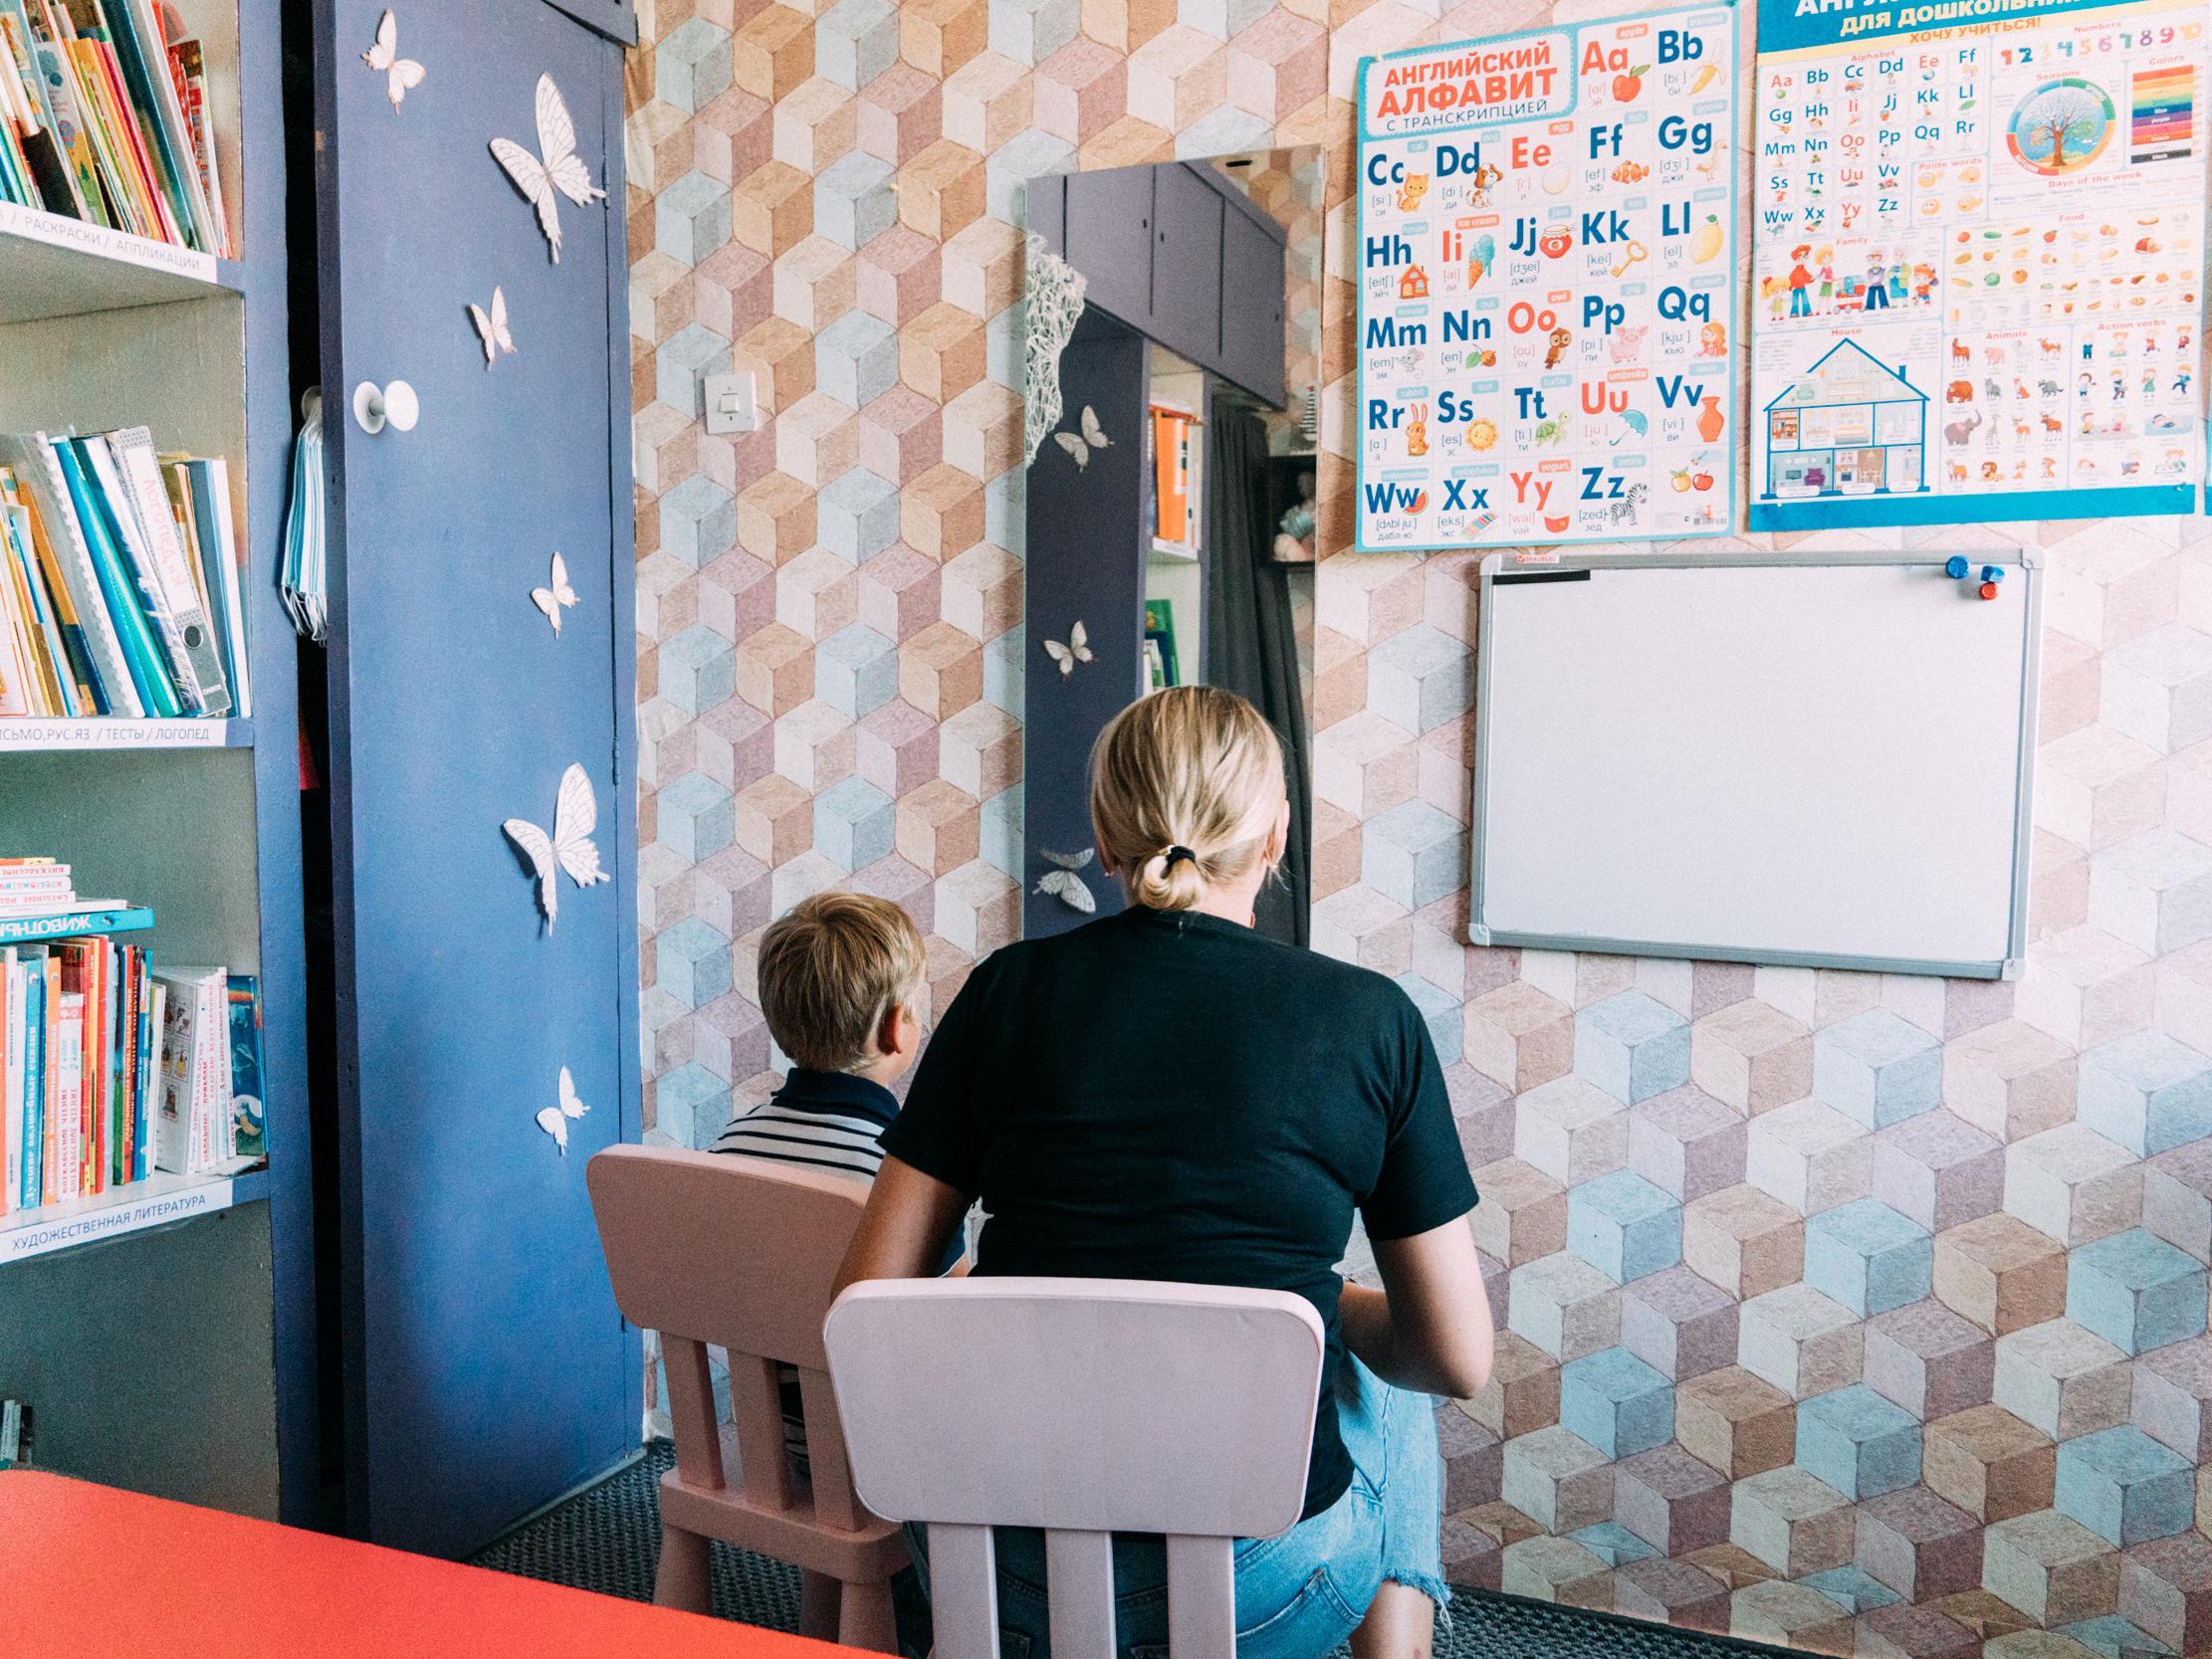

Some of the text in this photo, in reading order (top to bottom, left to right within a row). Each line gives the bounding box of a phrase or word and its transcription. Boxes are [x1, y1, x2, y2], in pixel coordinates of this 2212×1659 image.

[1840, 12, 1890, 37] ДЛЯ
[1909, 17, 2041, 44] ХОЧУ УЧИТЬСЯ!
[2074, 21, 2121, 33] Numbers
[1580, 41, 1628, 76] Aa
[1659, 30, 1702, 64] Bb
[1959, 48, 1976, 63] Ff
[2001, 50, 2012, 65] 1
[2018, 47, 2033, 64] 2
[2058, 41, 2073, 57] 4
[2080, 38, 2092, 55] 5
[2099, 36, 2112, 52] 6
[2140, 30, 2152, 46] 8
[2159, 27, 2174, 44] 9
[1385, 40, 1550, 88] АНГЛИЙСКИЙ
[1845, 65, 1865, 79] Cc
[1880, 58, 1903, 75] Dd
[1919, 55, 1939, 69] Ee
[2149, 55, 2185, 66] Colors
[1771, 75, 1793, 88] Aa
[1807, 69, 1829, 85] Bb
[1378, 68, 1557, 117] АЛФАВИТ
[1883, 94, 1896, 110] Jj
[1917, 89, 1939, 104] Kk
[1959, 85, 1974, 99] Ll
[1387, 100, 1547, 131] С ТРАНСКРИПЦИЕЙ
[1769, 108, 1792, 124] Gg
[1806, 103, 1829, 117] Hh
[1849, 100, 1859, 112] Ii
[1659, 115, 1712, 154] Gg
[1880, 129, 1900, 145] Pp
[1914, 125, 1940, 140] Qq
[1956, 120, 1975, 134] Rr
[1512, 136, 1551, 169] Ee
[1591, 123, 1623, 159] Ff
[1765, 142, 1795, 156] Mm
[1805, 138, 1828, 151] Nn
[1841, 134, 1865, 147] Oo
[1368, 154, 1403, 186] Cc
[1437, 141, 1479, 177] Dd
[1879, 164, 1900, 177] Vv
[1771, 176, 1788, 189] Ss
[1808, 172, 1824, 185] Tt
[1841, 168, 1864, 181] Uu
[1764, 210, 1793, 224] Ww
[1805, 207, 1825, 220] Xx
[1842, 203, 1861, 219] Yy
[1879, 198, 1898, 212] Zz
[1458, 216, 1498, 228] ice cream
[1582, 210, 1630, 246] Kk
[1662, 201, 1690, 237] Ll
[25, 215, 200, 270] РАСКРАСКИ АППЛИКАЦИИ
[1442, 231, 1461, 263] Ii
[1509, 217, 1536, 257] Jj
[1367, 235, 1412, 268] Hh
[1551, 293, 1567, 303] owl
[1658, 286, 1709, 322] Qq
[1443, 310, 1491, 342] Nn
[1507, 302, 1556, 334] Oo
[1583, 296, 1625, 334] Pp
[2098, 318, 2166, 331] Action verbs
[1366, 316, 1427, 348] Mm
[1986, 330, 2028, 340] Animals
[1514, 387, 1547, 419] Tt
[1582, 381, 1628, 414] Uu
[1656, 375, 1703, 409] Vv
[1369, 399, 1405, 430] Rr
[1438, 390, 1473, 423] Ss
[1542, 461, 1570, 472] yogurt
[1441, 479, 1489, 511] Xx
[1510, 472, 1553, 511] Yy
[1581, 467, 1625, 501] Zz
[1365, 483, 1420, 514] Ww
[0, 726, 209, 741] СЬМО,РУС.ЯЗ ТЕСТЫ ЛОГОПЕД
[26, 1074, 37, 1147] волшебные
[25, 1150, 38, 1202] Лучшие
[12, 1194, 206, 1251] ХУДОЖЕСТВЕННАЯ ЛИТЕРАТУРА
